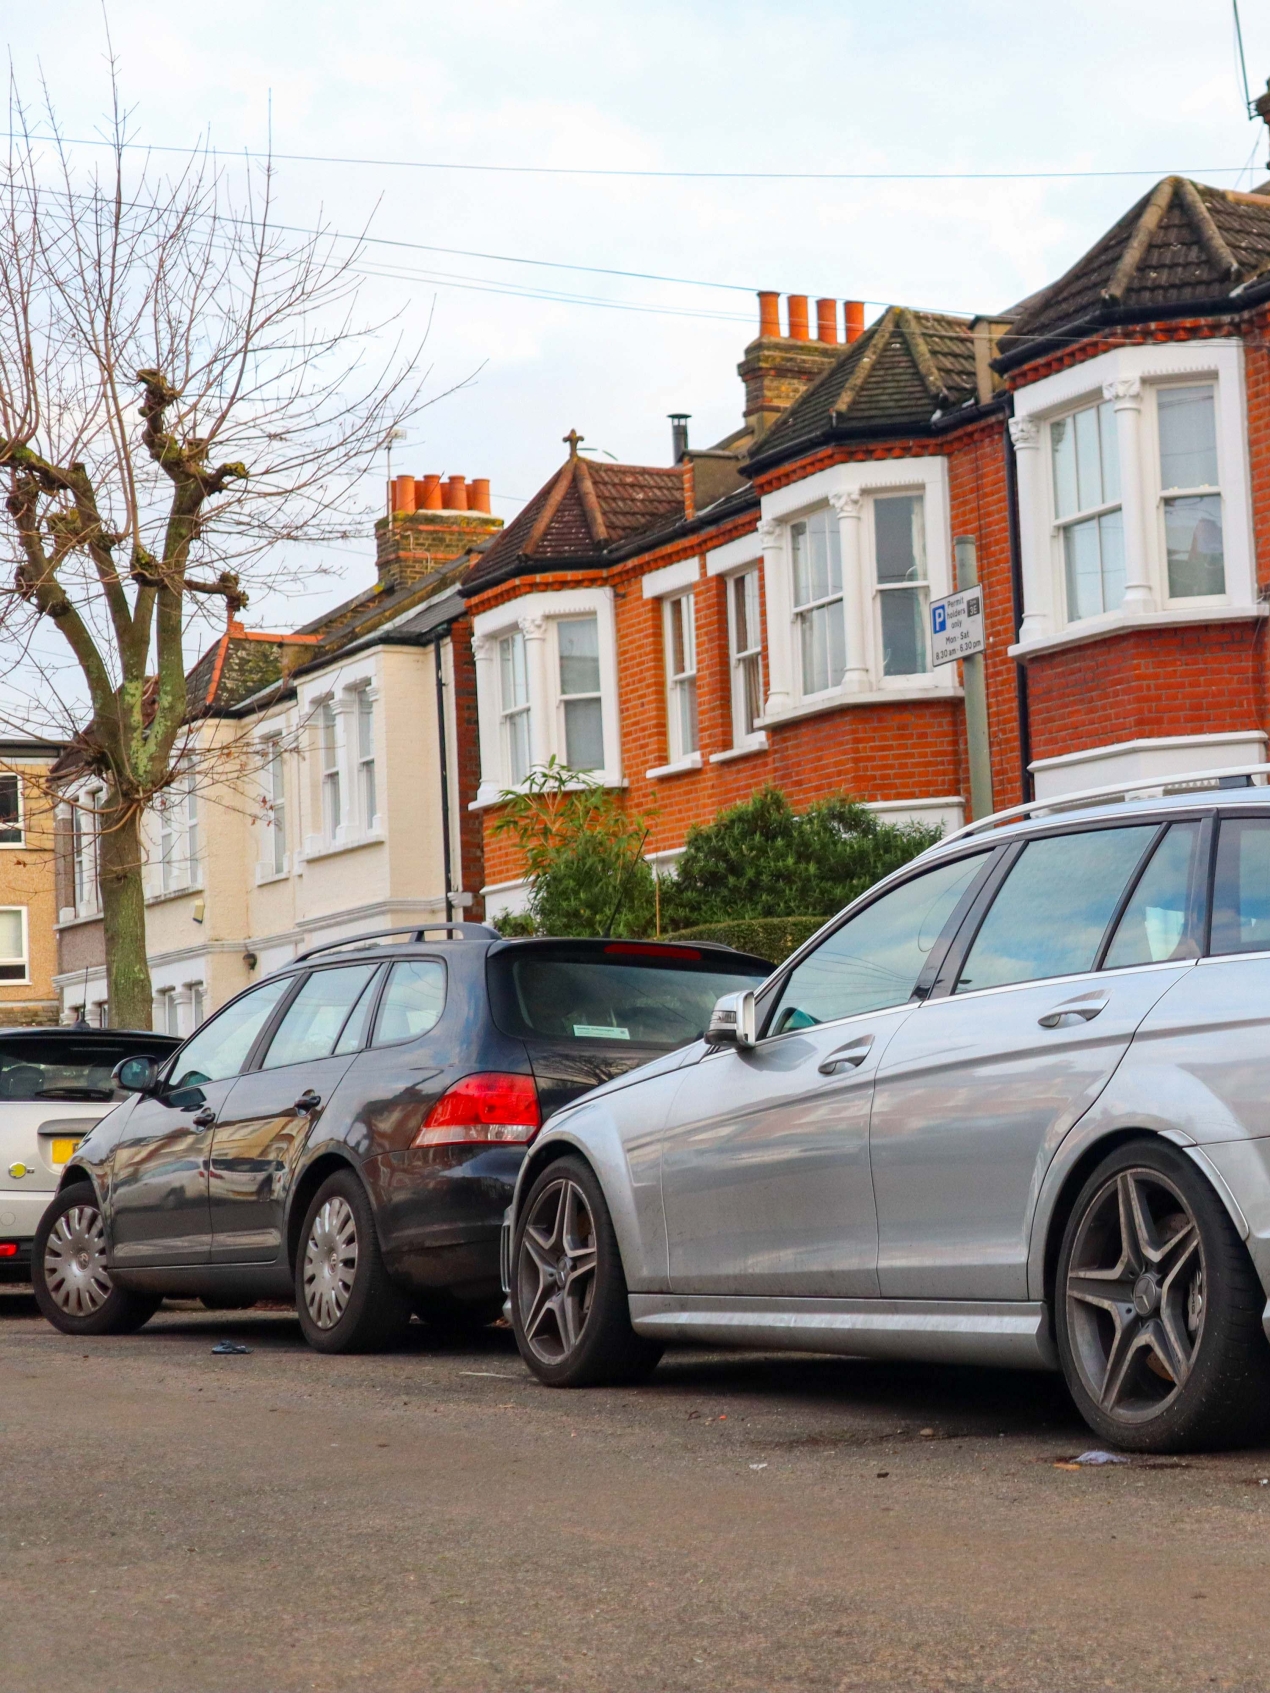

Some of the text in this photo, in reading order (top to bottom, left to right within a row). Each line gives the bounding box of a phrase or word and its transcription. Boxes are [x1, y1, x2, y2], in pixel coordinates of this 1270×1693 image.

[947, 597, 964, 609] Permit
[947, 608, 966, 620] holders
[969, 605, 978, 615] 3E
[935, 609, 944, 631] P
[951, 619, 962, 629] only
[946, 636, 957, 645] Mon
[960, 630, 970, 641] Sat
[936, 649, 948, 660] 8.30
[948, 648, 957, 657] am
[960, 641, 972, 652] 6.30
[972, 640, 981, 649] pm
